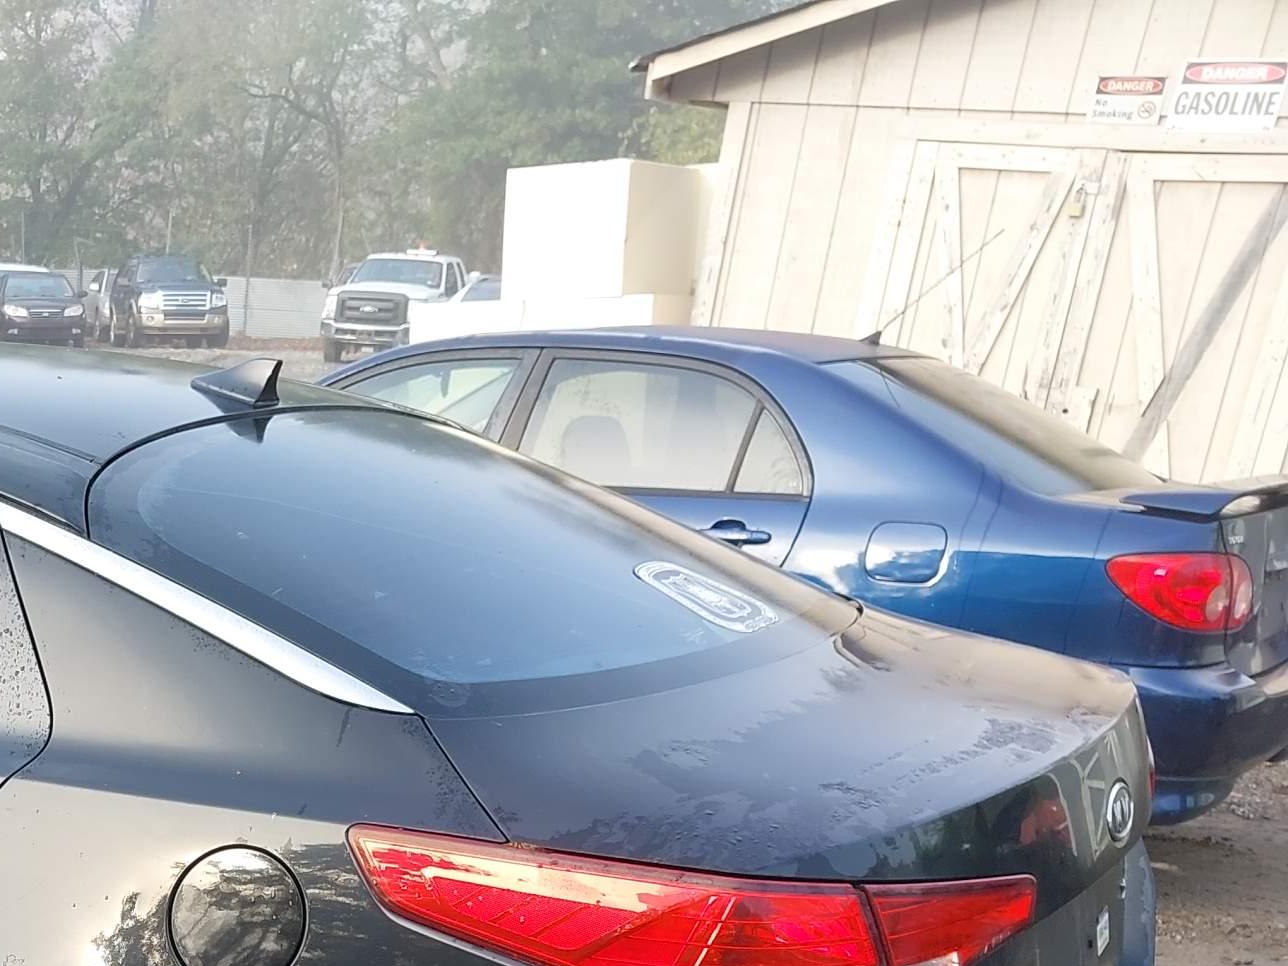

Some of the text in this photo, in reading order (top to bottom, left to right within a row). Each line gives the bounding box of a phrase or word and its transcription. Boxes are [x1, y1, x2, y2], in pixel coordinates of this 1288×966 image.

[1202, 66, 1268, 80] DANGER
[1107, 78, 1154, 92] DANGER
[1094, 98, 1108, 107] No
[1174, 91, 1280, 117] GASOLINE
[1091, 109, 1133, 120] Smoking
